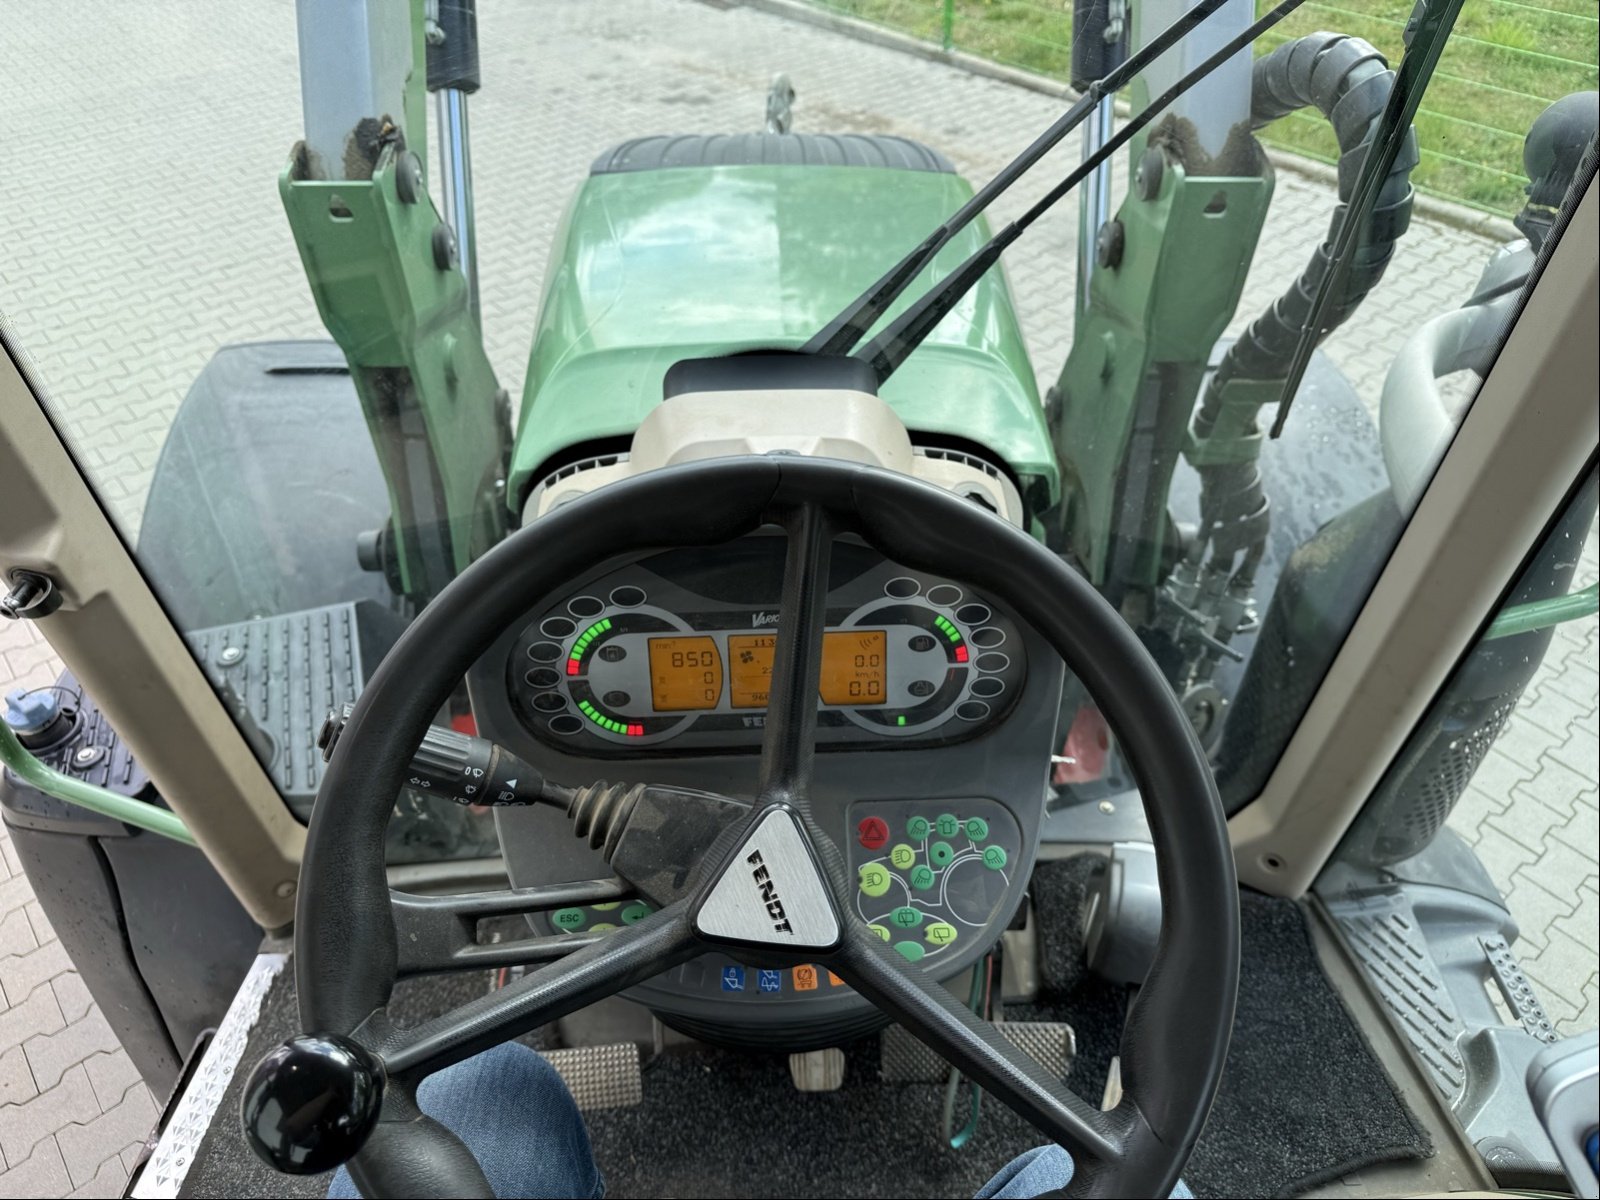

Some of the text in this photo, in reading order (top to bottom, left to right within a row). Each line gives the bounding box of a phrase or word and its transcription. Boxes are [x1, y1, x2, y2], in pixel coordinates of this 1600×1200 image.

[671, 651, 713, 668] 850
[855, 654, 880, 667] 0.0
[704, 671, 714, 684] 0
[705, 688, 715, 701] 0
[849, 680, 880, 696] 0.0
[746, 849, 794, 936] FENDT
[560, 913, 580, 923] ESC
